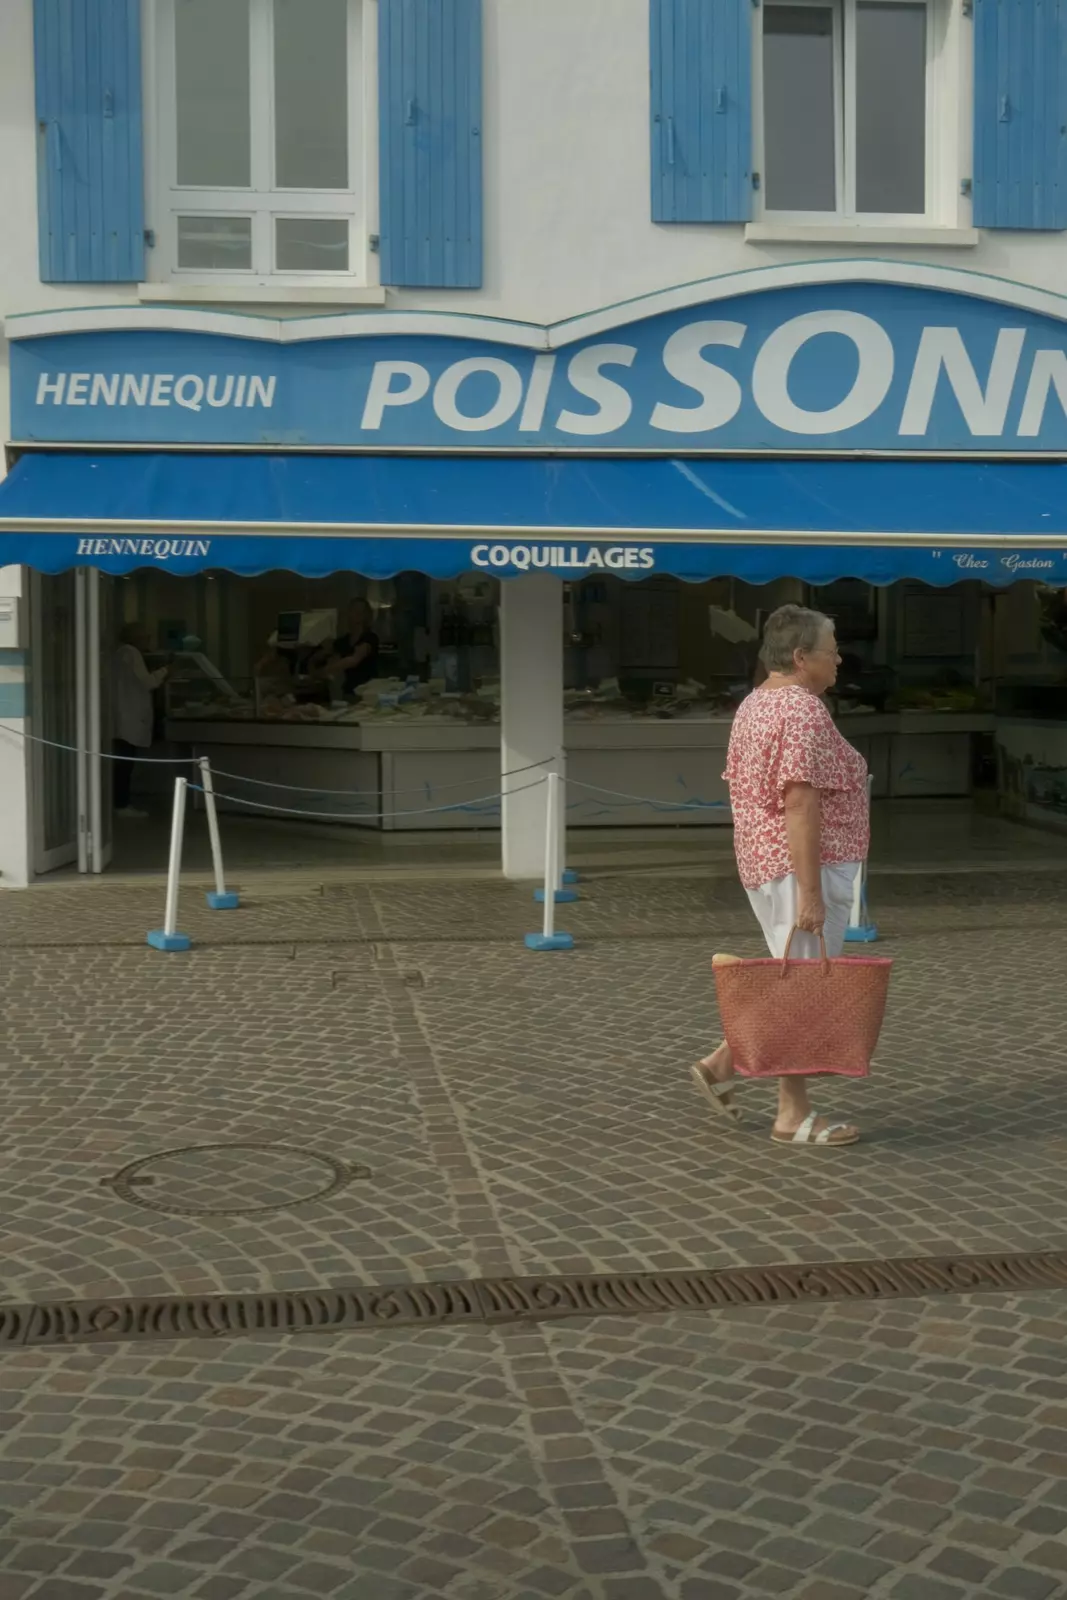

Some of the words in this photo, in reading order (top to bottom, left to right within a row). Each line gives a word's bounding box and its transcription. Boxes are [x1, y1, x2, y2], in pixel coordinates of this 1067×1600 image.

[36, 373, 276, 411] HENNEQUIN
[76, 538, 211, 559] HENNEQUIN
[470, 545, 655, 570] COQUILLAGES
[952, 553, 989, 569] Chez
[1000, 554, 1055, 572] Gaston
